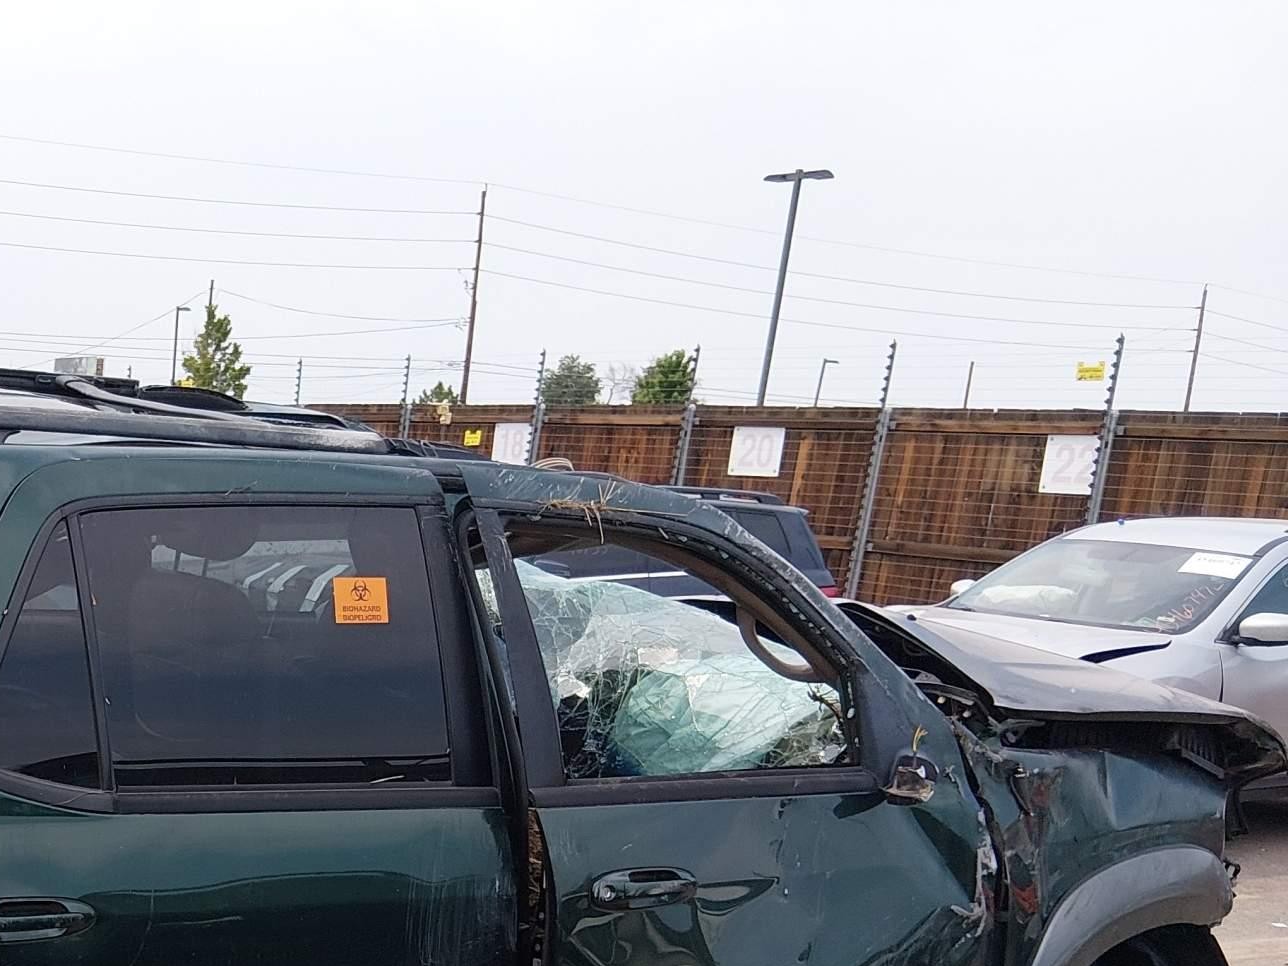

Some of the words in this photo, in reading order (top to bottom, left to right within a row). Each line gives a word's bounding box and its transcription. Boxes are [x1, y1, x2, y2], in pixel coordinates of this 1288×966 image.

[502, 429, 524, 459] 18
[737, 433, 775, 468] 20
[342, 605, 382, 613] BIOHAZARD
